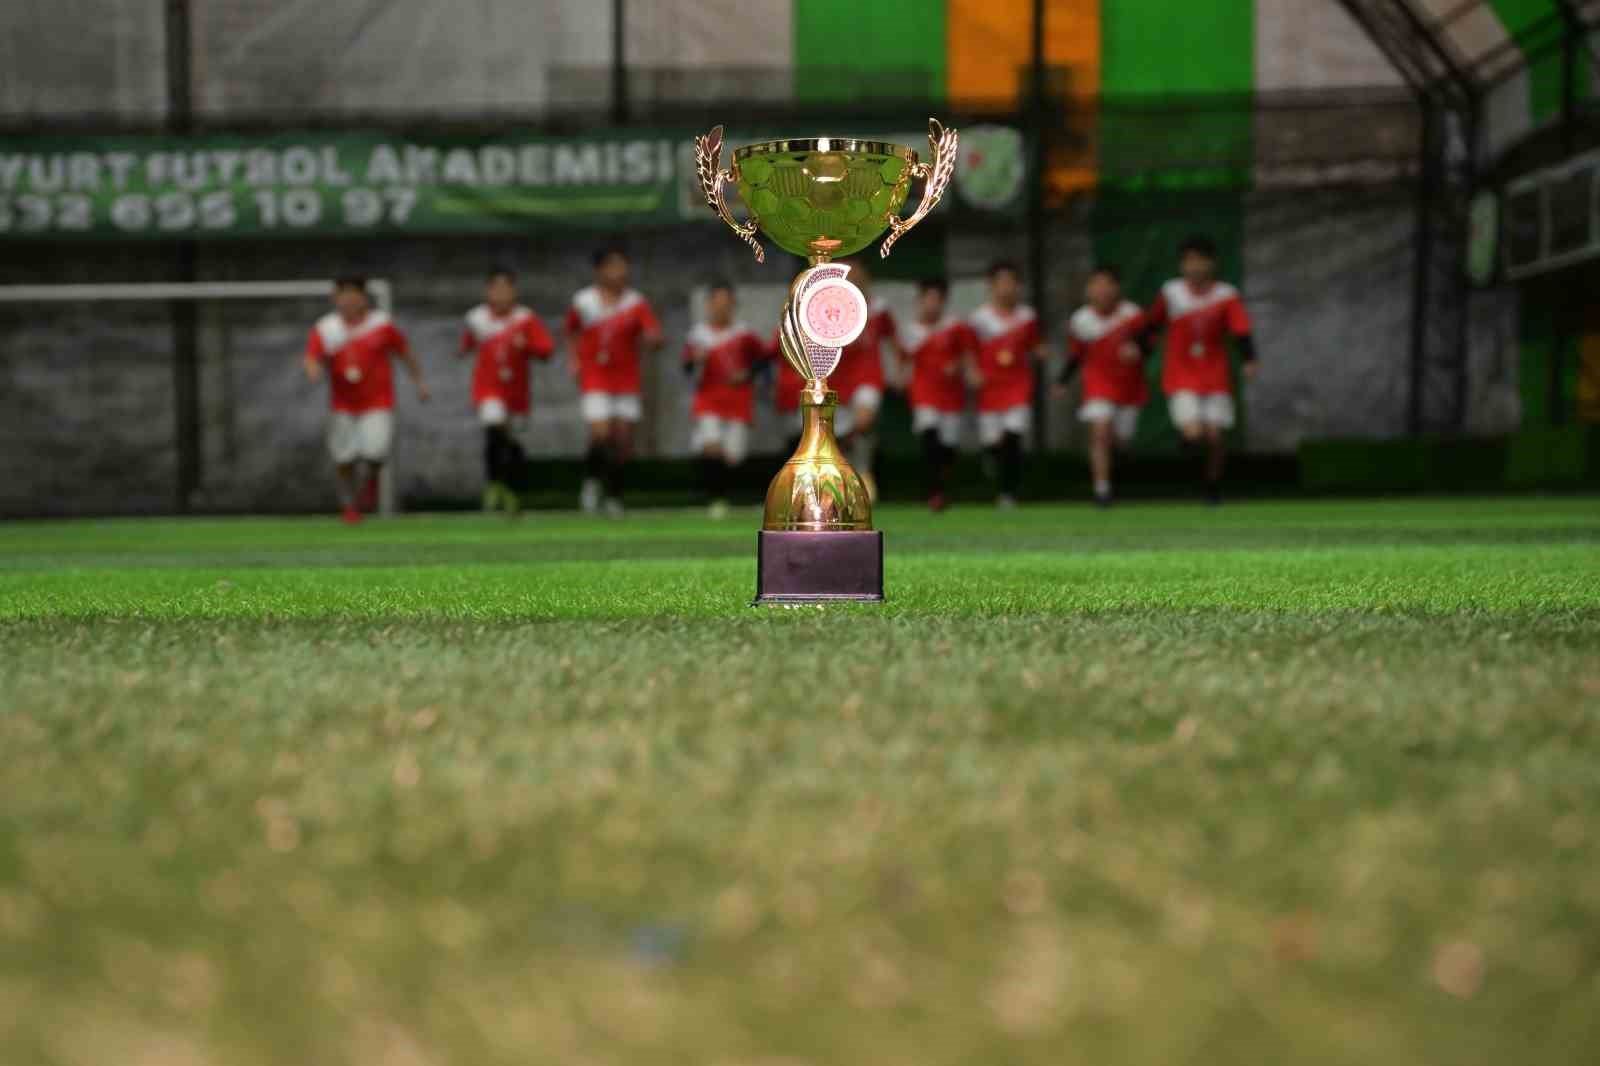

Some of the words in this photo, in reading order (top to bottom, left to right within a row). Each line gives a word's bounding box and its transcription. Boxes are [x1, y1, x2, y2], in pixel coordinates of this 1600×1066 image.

[147, 146, 353, 190] FUTBOL
[256, 187, 321, 227] 10
[343, 187, 417, 225] 97
